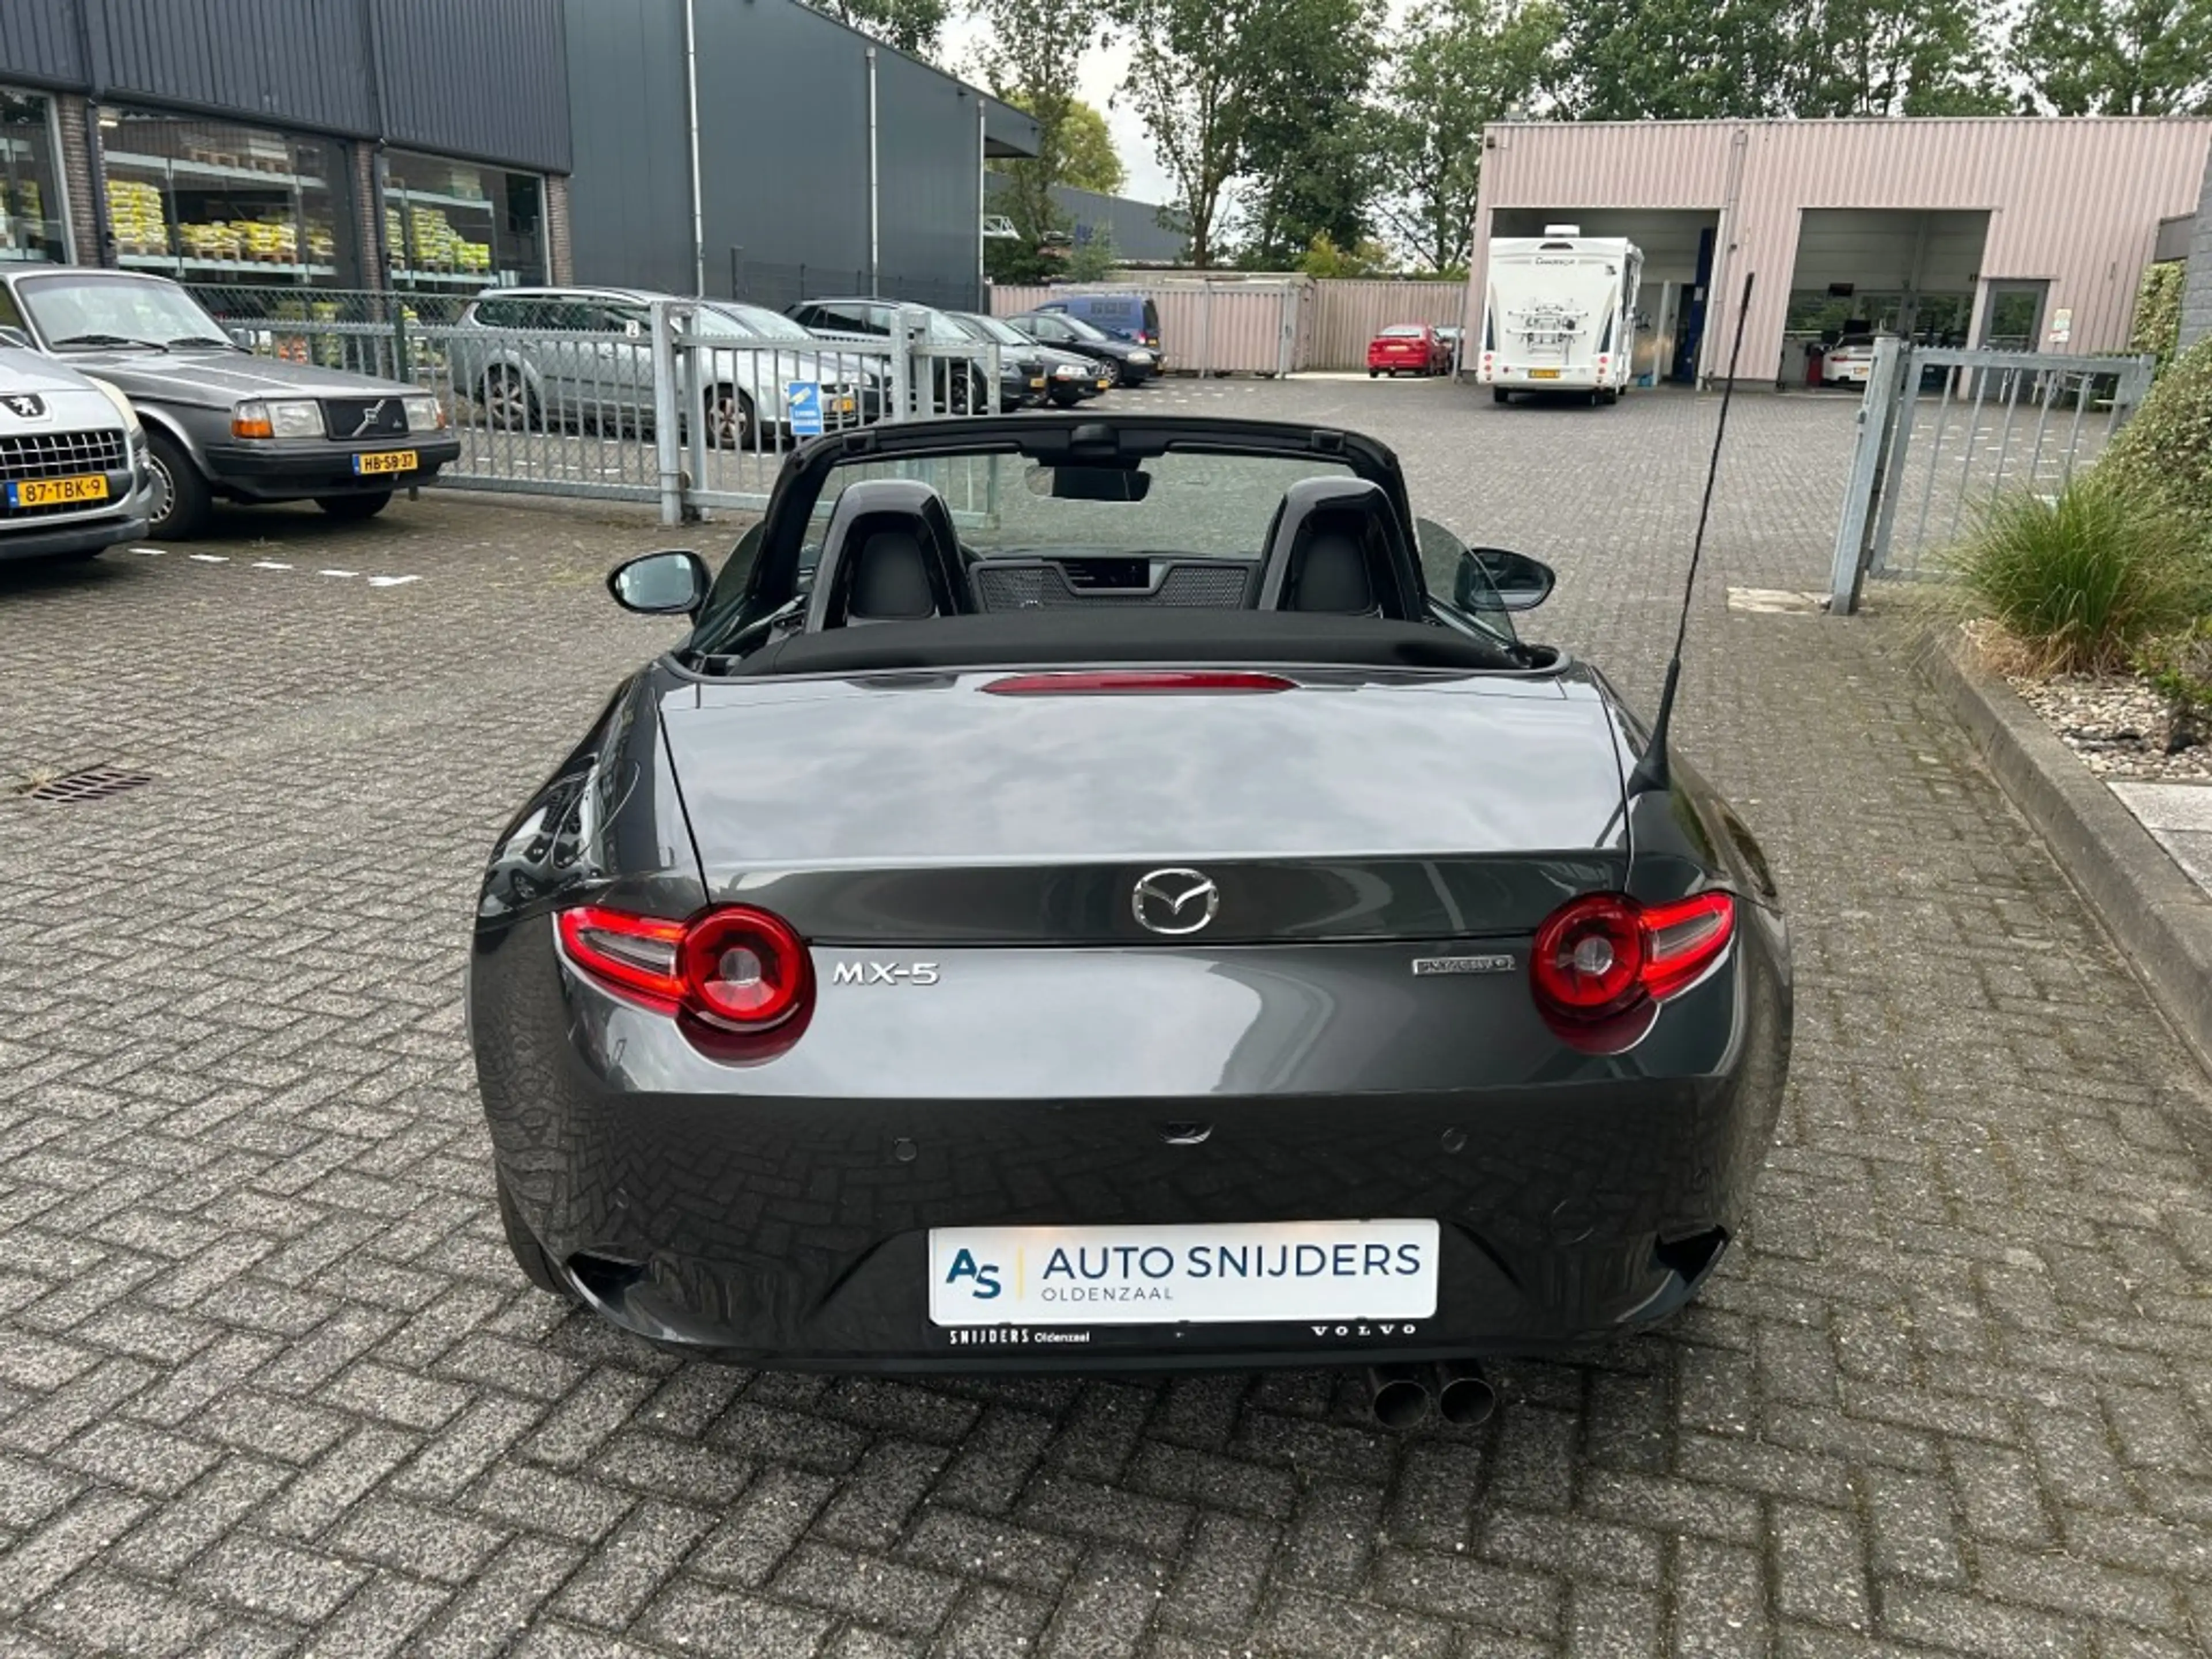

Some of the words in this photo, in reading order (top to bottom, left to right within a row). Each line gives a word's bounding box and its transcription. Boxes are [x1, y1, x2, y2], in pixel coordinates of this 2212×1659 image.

[26, 479, 100, 502] 87-TBK-9
[833, 961, 940, 986] MX-5
[1043, 1247, 1174, 1279] AUTO
[1187, 1244, 1421, 1278] SNIJDERS
[946, 1248, 1001, 1299] AS
[1041, 1286, 1173, 1301] OLDENZAAL
[950, 1328, 1029, 1344] SNIJDERS
[1310, 1324, 1416, 1336] VOLVO
